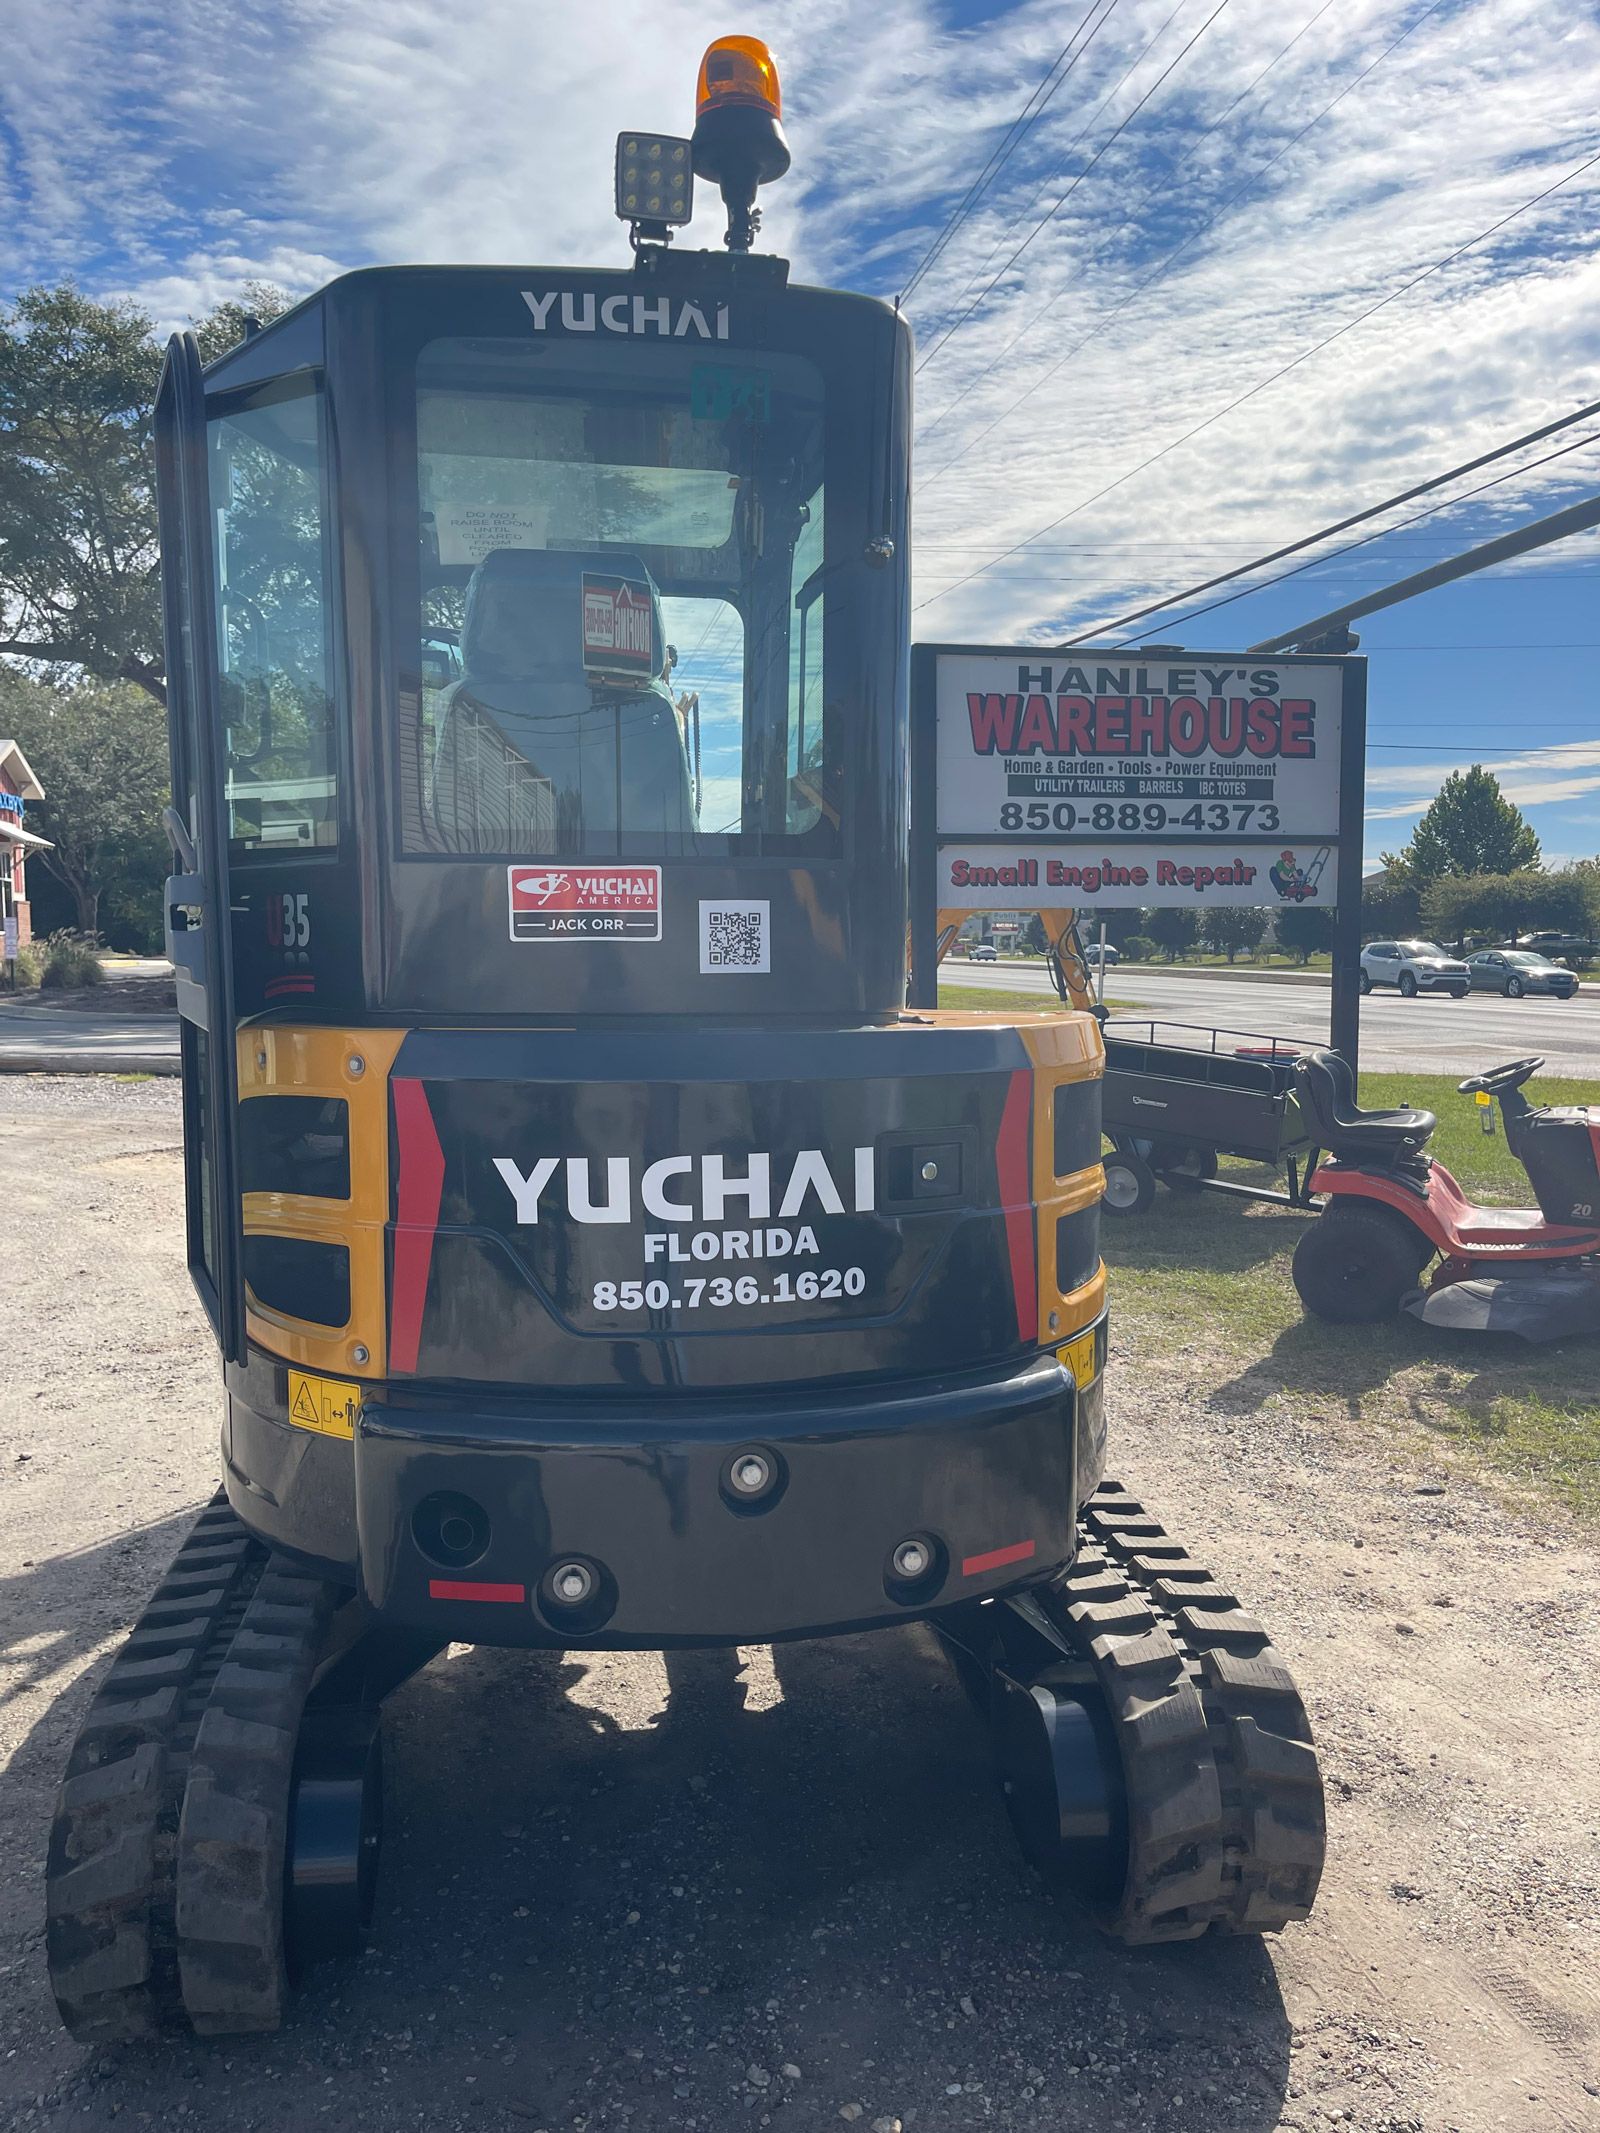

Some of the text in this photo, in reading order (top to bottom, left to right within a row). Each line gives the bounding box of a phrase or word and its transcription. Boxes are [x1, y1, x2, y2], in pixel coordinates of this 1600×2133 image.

[521, 292, 728, 340] YUCHAI
[490, 512, 519, 520] NOT
[494, 520, 532, 528] BOOM
[1018, 666, 1280, 697] HANLEY'S
[966, 692, 1316, 760] WAREHOUSE
[1004, 759, 1277, 778] Home & Garden Tools Power Equipment
[1034, 779, 1247, 796] UTILITY TRAILERS BARRELS IBC TOTES
[1000, 802, 1280, 831] 850-889-4373
[576, 877, 654, 895] YUCHAI
[951, 858, 1257, 893] Small Engine Repair
[576, 896, 654, 905] AMERICA
[548, 919, 624, 931] JACK ORR
[491, 1146, 875, 1225] YUCHAI
[1571, 1203, 1592, 1217] 20
[644, 1226, 820, 1263] FLORIDA
[592, 1266, 866, 1312] 850.736.1620
